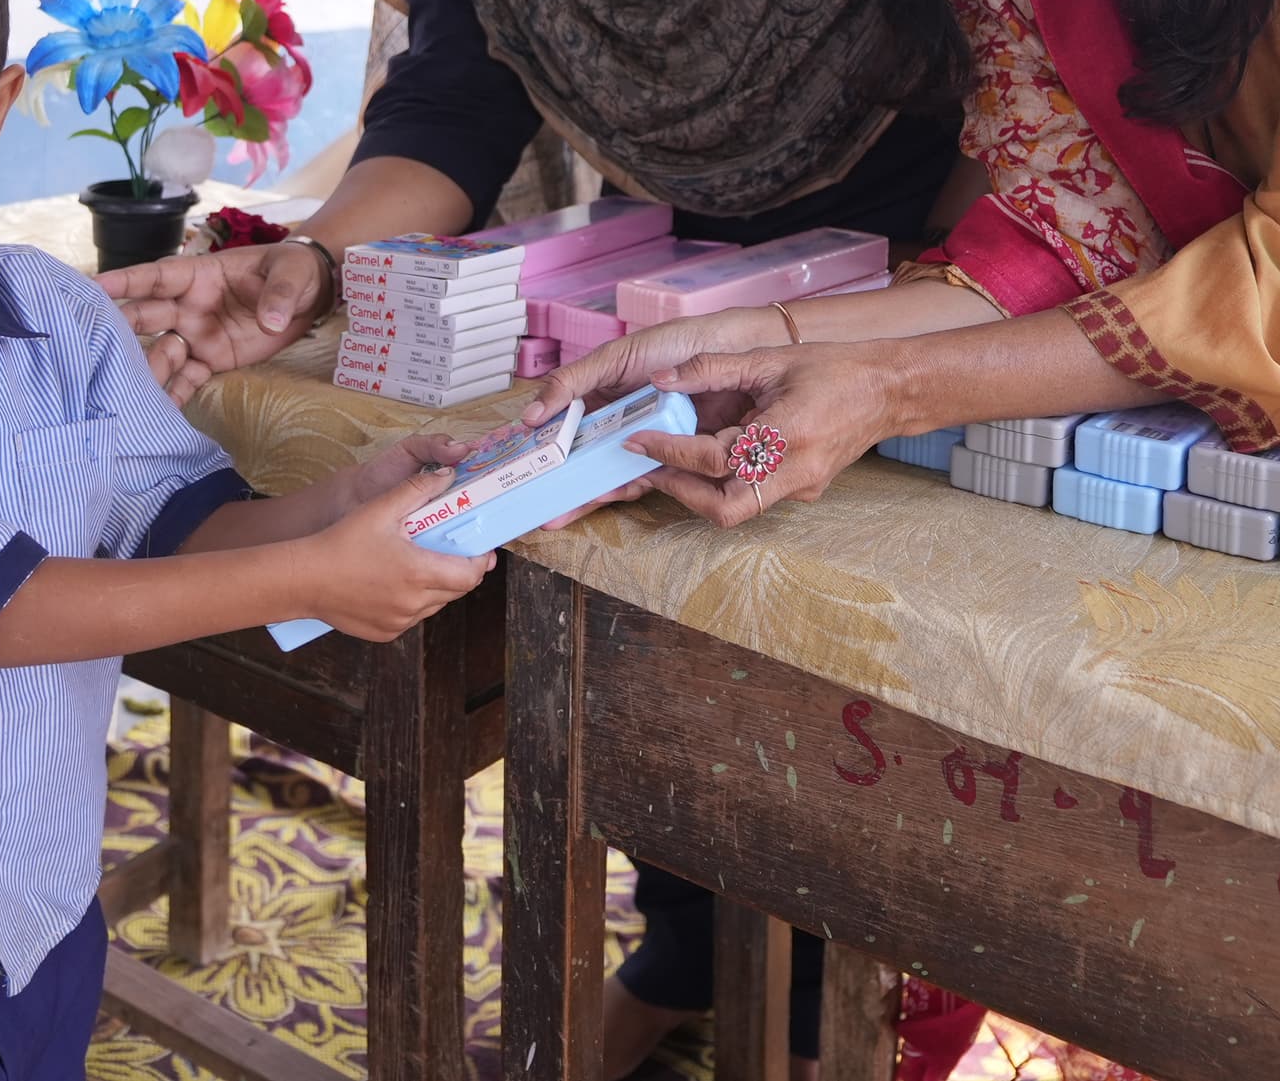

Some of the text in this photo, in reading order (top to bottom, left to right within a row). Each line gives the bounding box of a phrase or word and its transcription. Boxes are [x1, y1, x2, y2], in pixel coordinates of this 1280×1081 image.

[347, 252, 380, 267] Camel
[345, 269, 376, 285] Camel
[345, 286, 374, 303] Camel
[350, 305, 382, 320] Camel
[352, 321, 384, 337] Camel
[344, 338, 377, 355] Camel
[341, 356, 374, 372] Camel
[337, 373, 369, 391] Camel
[537, 454, 548, 464] 10
[497, 471, 514, 483] WAX
[501, 471, 533, 489] CRAYONS
[404, 502, 455, 535] Camel
